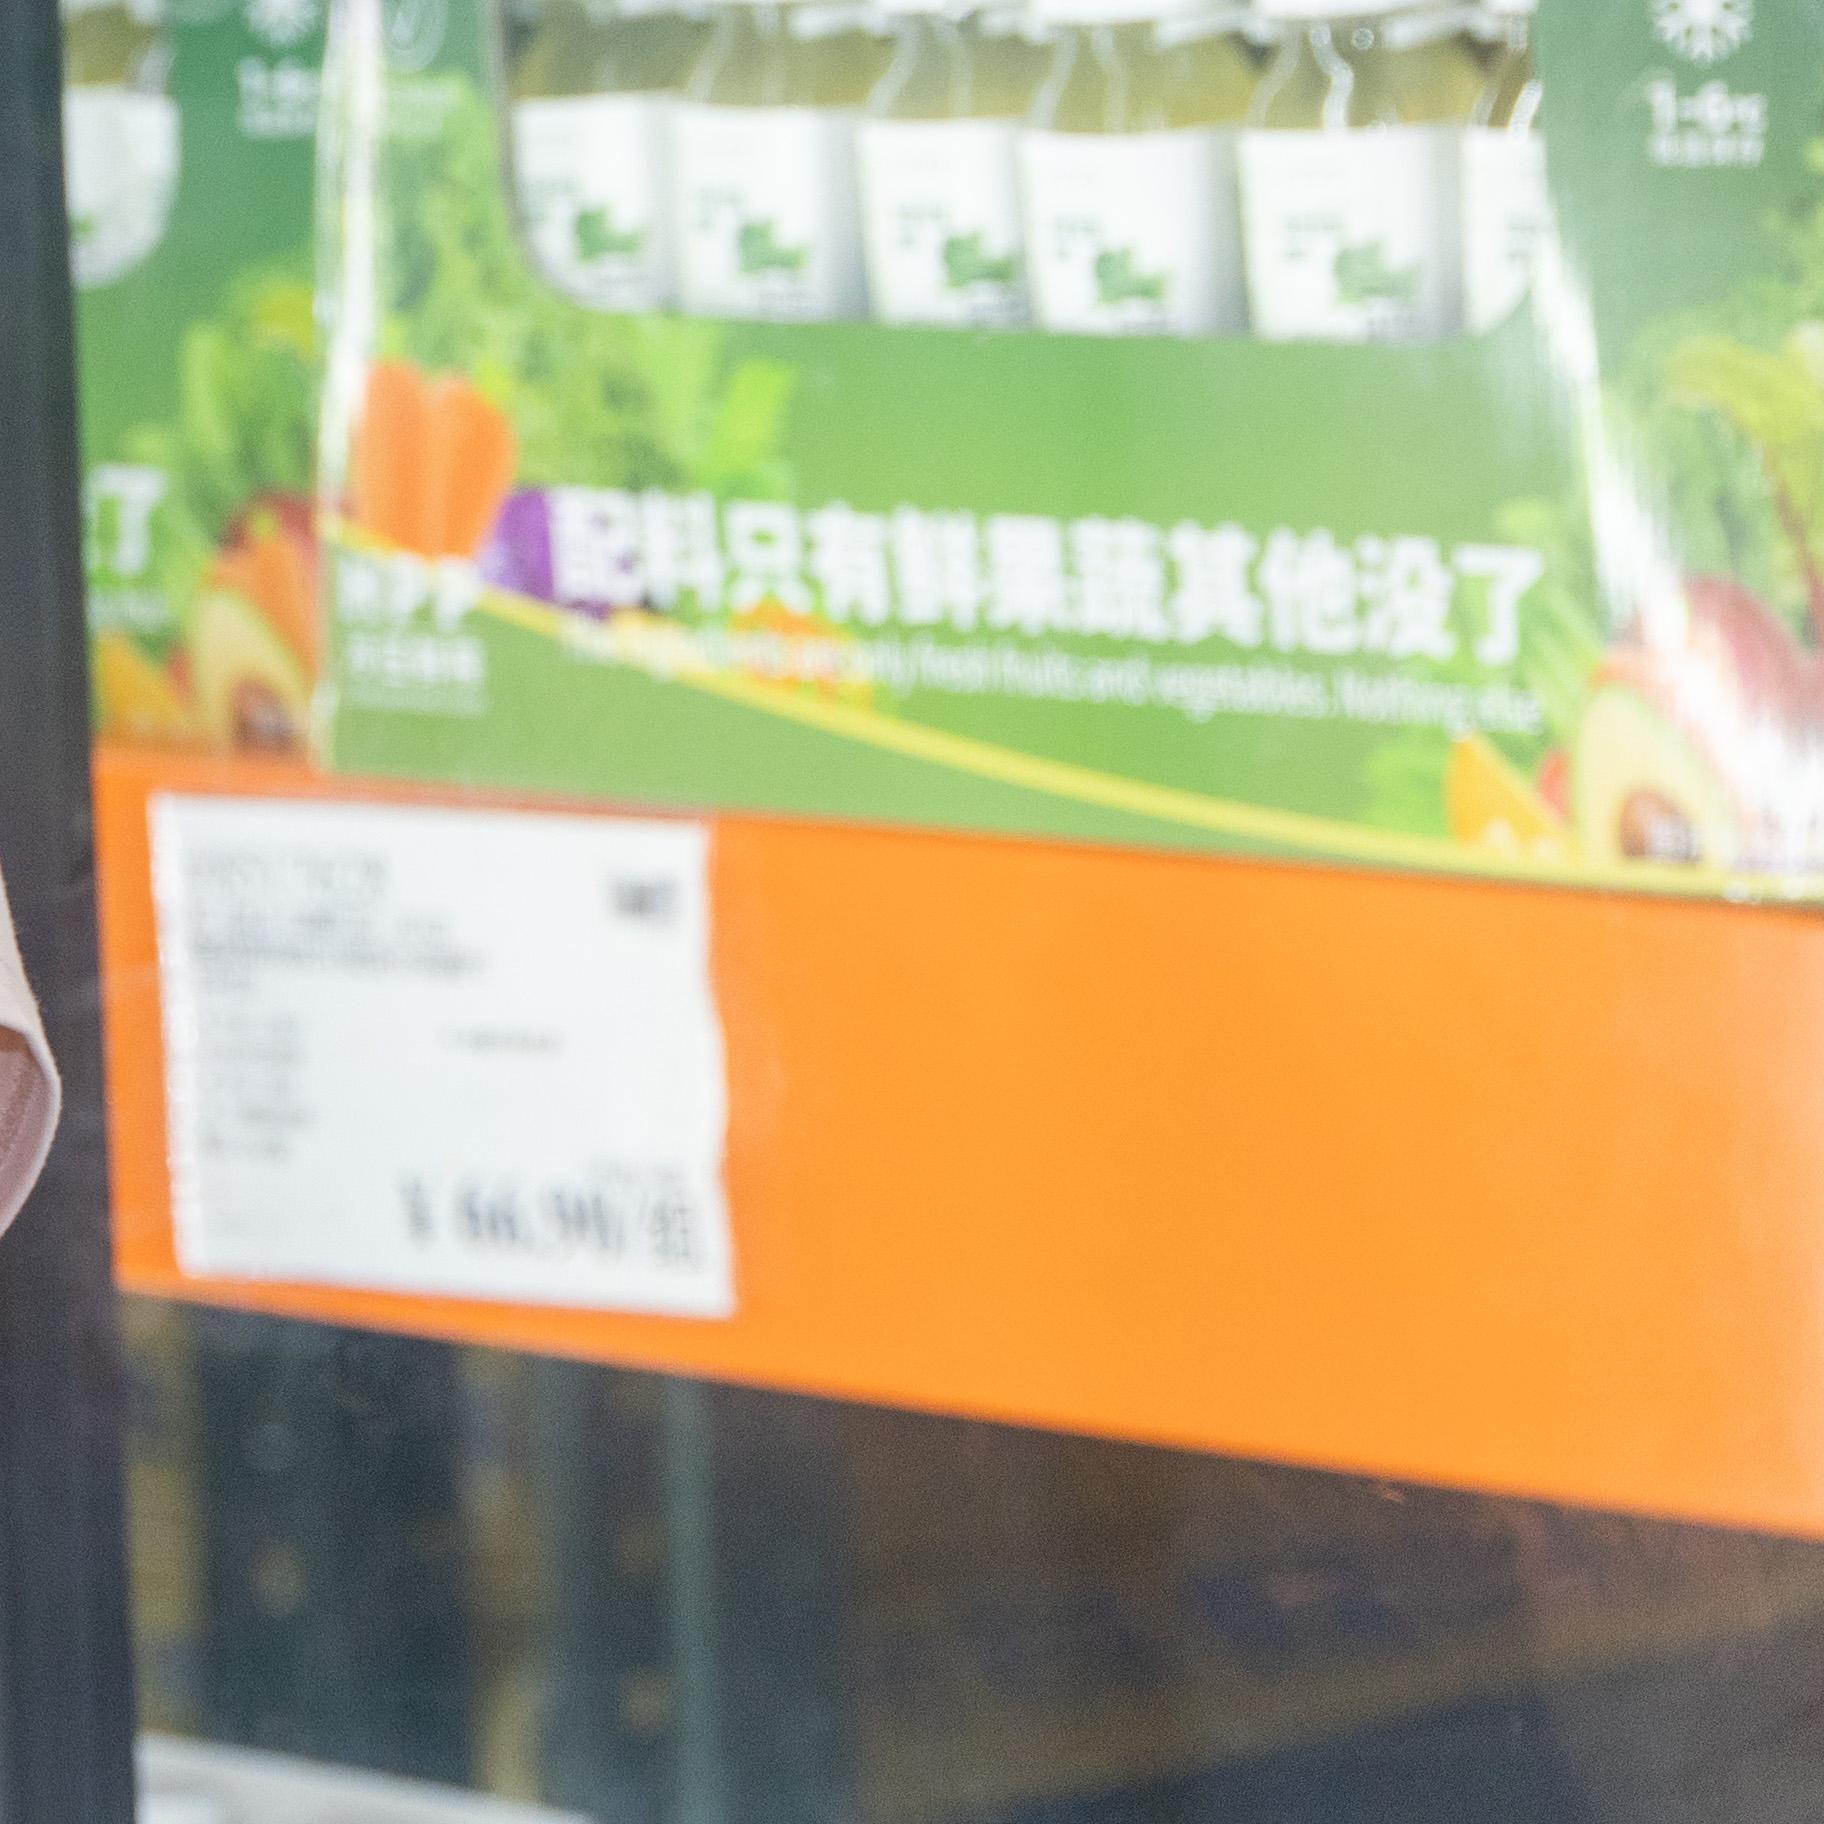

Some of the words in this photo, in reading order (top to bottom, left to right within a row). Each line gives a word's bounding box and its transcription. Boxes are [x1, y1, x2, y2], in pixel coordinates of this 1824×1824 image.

[553, 485, 1542, 664] 配料只有鲜果蔬其他没了
